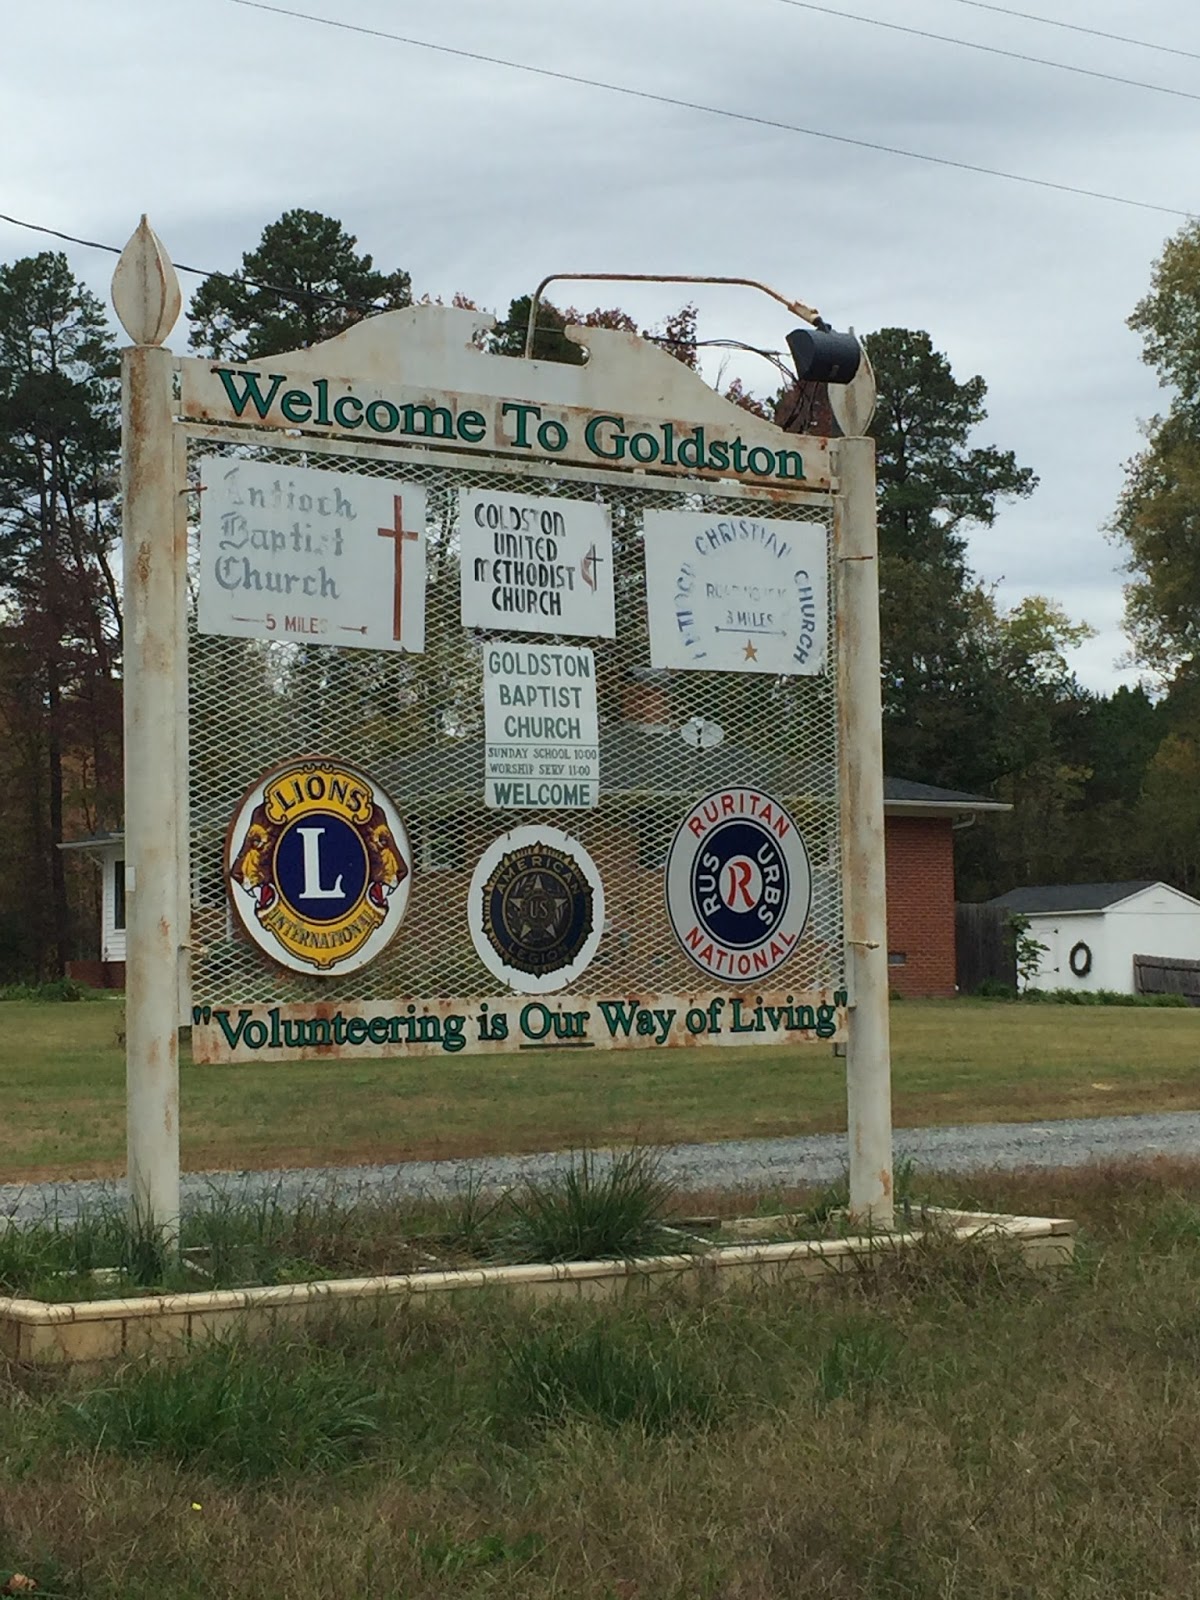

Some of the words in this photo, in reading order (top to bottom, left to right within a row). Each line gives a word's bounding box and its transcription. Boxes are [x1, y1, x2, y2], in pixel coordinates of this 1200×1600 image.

[211, 367, 486, 443] Welcome
[502, 402, 568, 452] To
[584, 415, 806, 480] Goldston
[494, 532, 558, 562] UNITED
[215, 555, 340, 600] Church
[474, 557, 576, 591] METHODIST
[491, 585, 562, 616] CHURCH
[792, 569, 816, 665] CHURCH
[265, 613, 277, 631] 5
[284, 615, 329, 635] MILES
[488, 650, 590, 678] GOLDSTON
[499, 683, 582, 709] BAPTIST
[504, 715, 581, 739] CHURCH
[487, 747, 528, 760] SUNDAY
[533, 748, 571, 761] SCHOOL
[489, 762, 535, 776] WORSHIP
[273, 773, 368, 812] LIONS
[493, 782, 590, 806] WELCOME
[688, 793, 790, 839] RURITAN
[296, 827, 346, 899] L
[496, 855, 581, 895] AMERICAN
[698, 852, 722, 917] RUS
[727, 861, 755, 908] R
[757, 842, 782, 926] URBS
[529, 900, 549, 919] US
[685, 926, 796, 976] NATIONAL
[477, 1002, 509, 1041] is
[519, 1002, 590, 1040] Our
[597, 1000, 677, 1045] Way
[685, 997, 725, 1034] of
